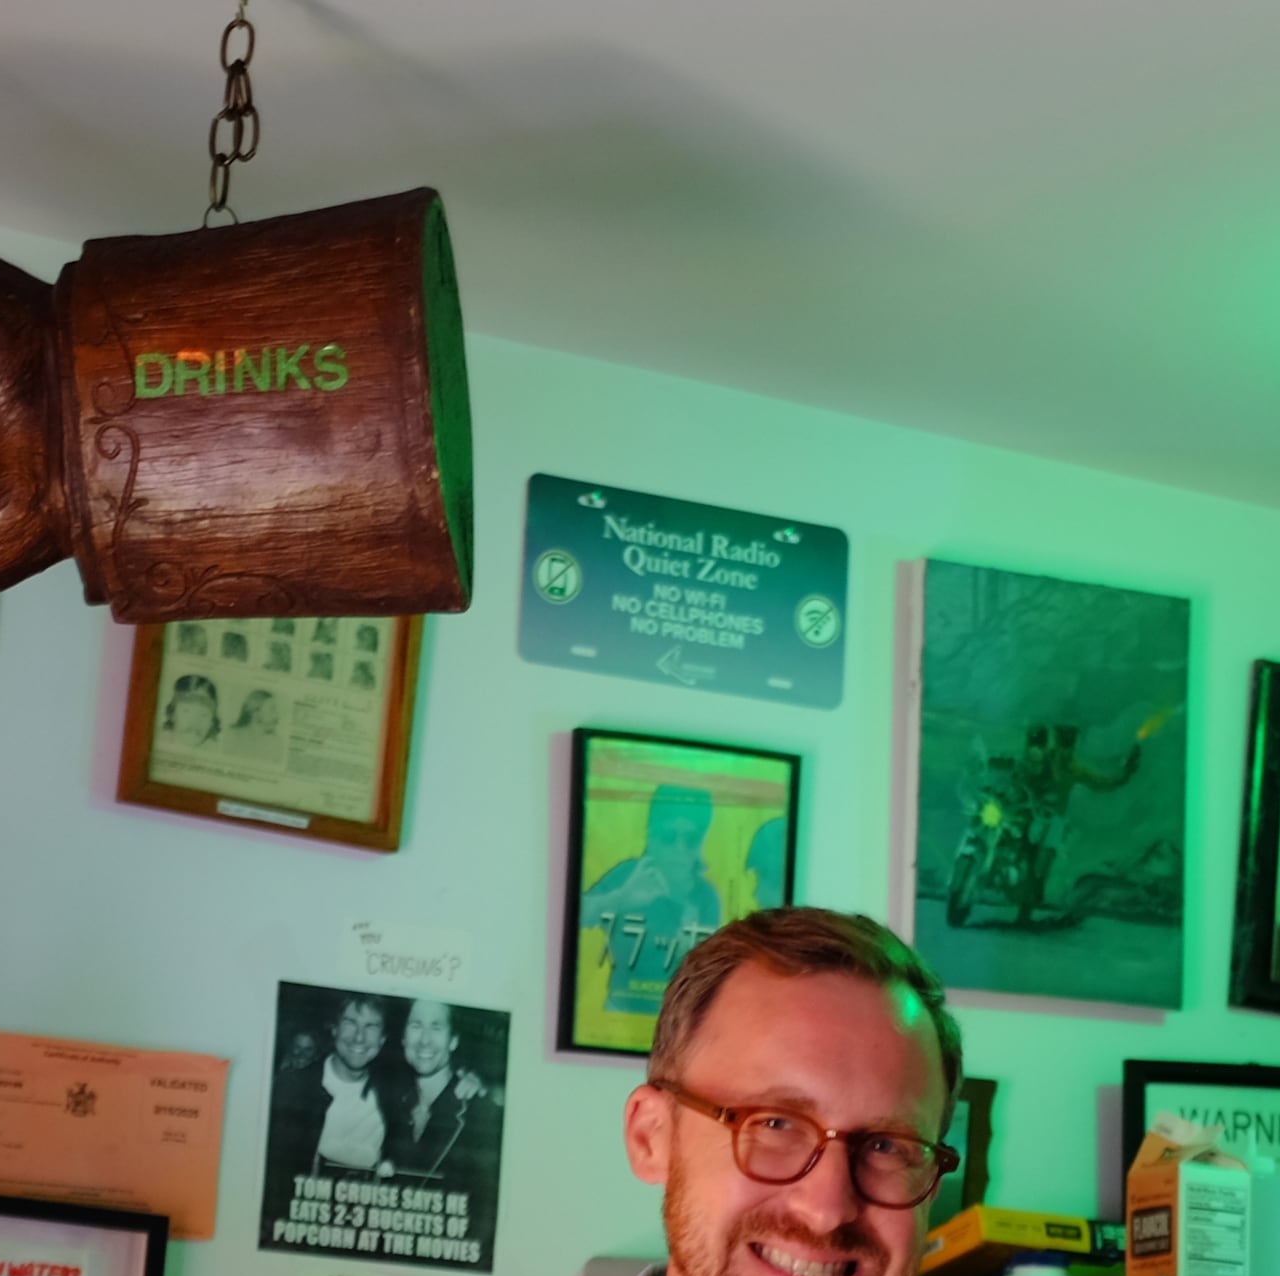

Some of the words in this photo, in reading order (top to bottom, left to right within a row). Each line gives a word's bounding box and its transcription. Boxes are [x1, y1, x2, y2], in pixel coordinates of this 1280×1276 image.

[134, 343, 349, 400] DRINKS
[602, 514, 704, 555] National
[711, 533, 781, 568] Radio
[622, 544, 690, 577] Quiet
[696, 557, 758, 591] Zone
[611, 594, 642, 614] NO
[645, 599, 765, 636] CELLPHONES
[652, 583, 681, 603] NO
[684, 588, 727, 611] WI-FI
[630, 616, 658, 636] NO
[661, 621, 746, 650] PROBLEM
[150, 1077, 209, 1094] VALIDATED
[293, 1176, 333, 1200] TOM
[334, 1180, 400, 1208] CRUISE
[401, 1187, 444, 1214] SAYS
[445, 1192, 469, 1216] HE
[289, 1199, 332, 1224] EATS
[333, 1204, 365, 1228] 2-3
[367, 1207, 444, 1237] BUCKETS
[446, 1215, 469, 1239] OF
[272, 1219, 357, 1249] POPCORN
[357, 1229, 380, 1252] AT
[382, 1232, 415, 1256] THE
[415, 1236, 481, 1264] MOVIES
